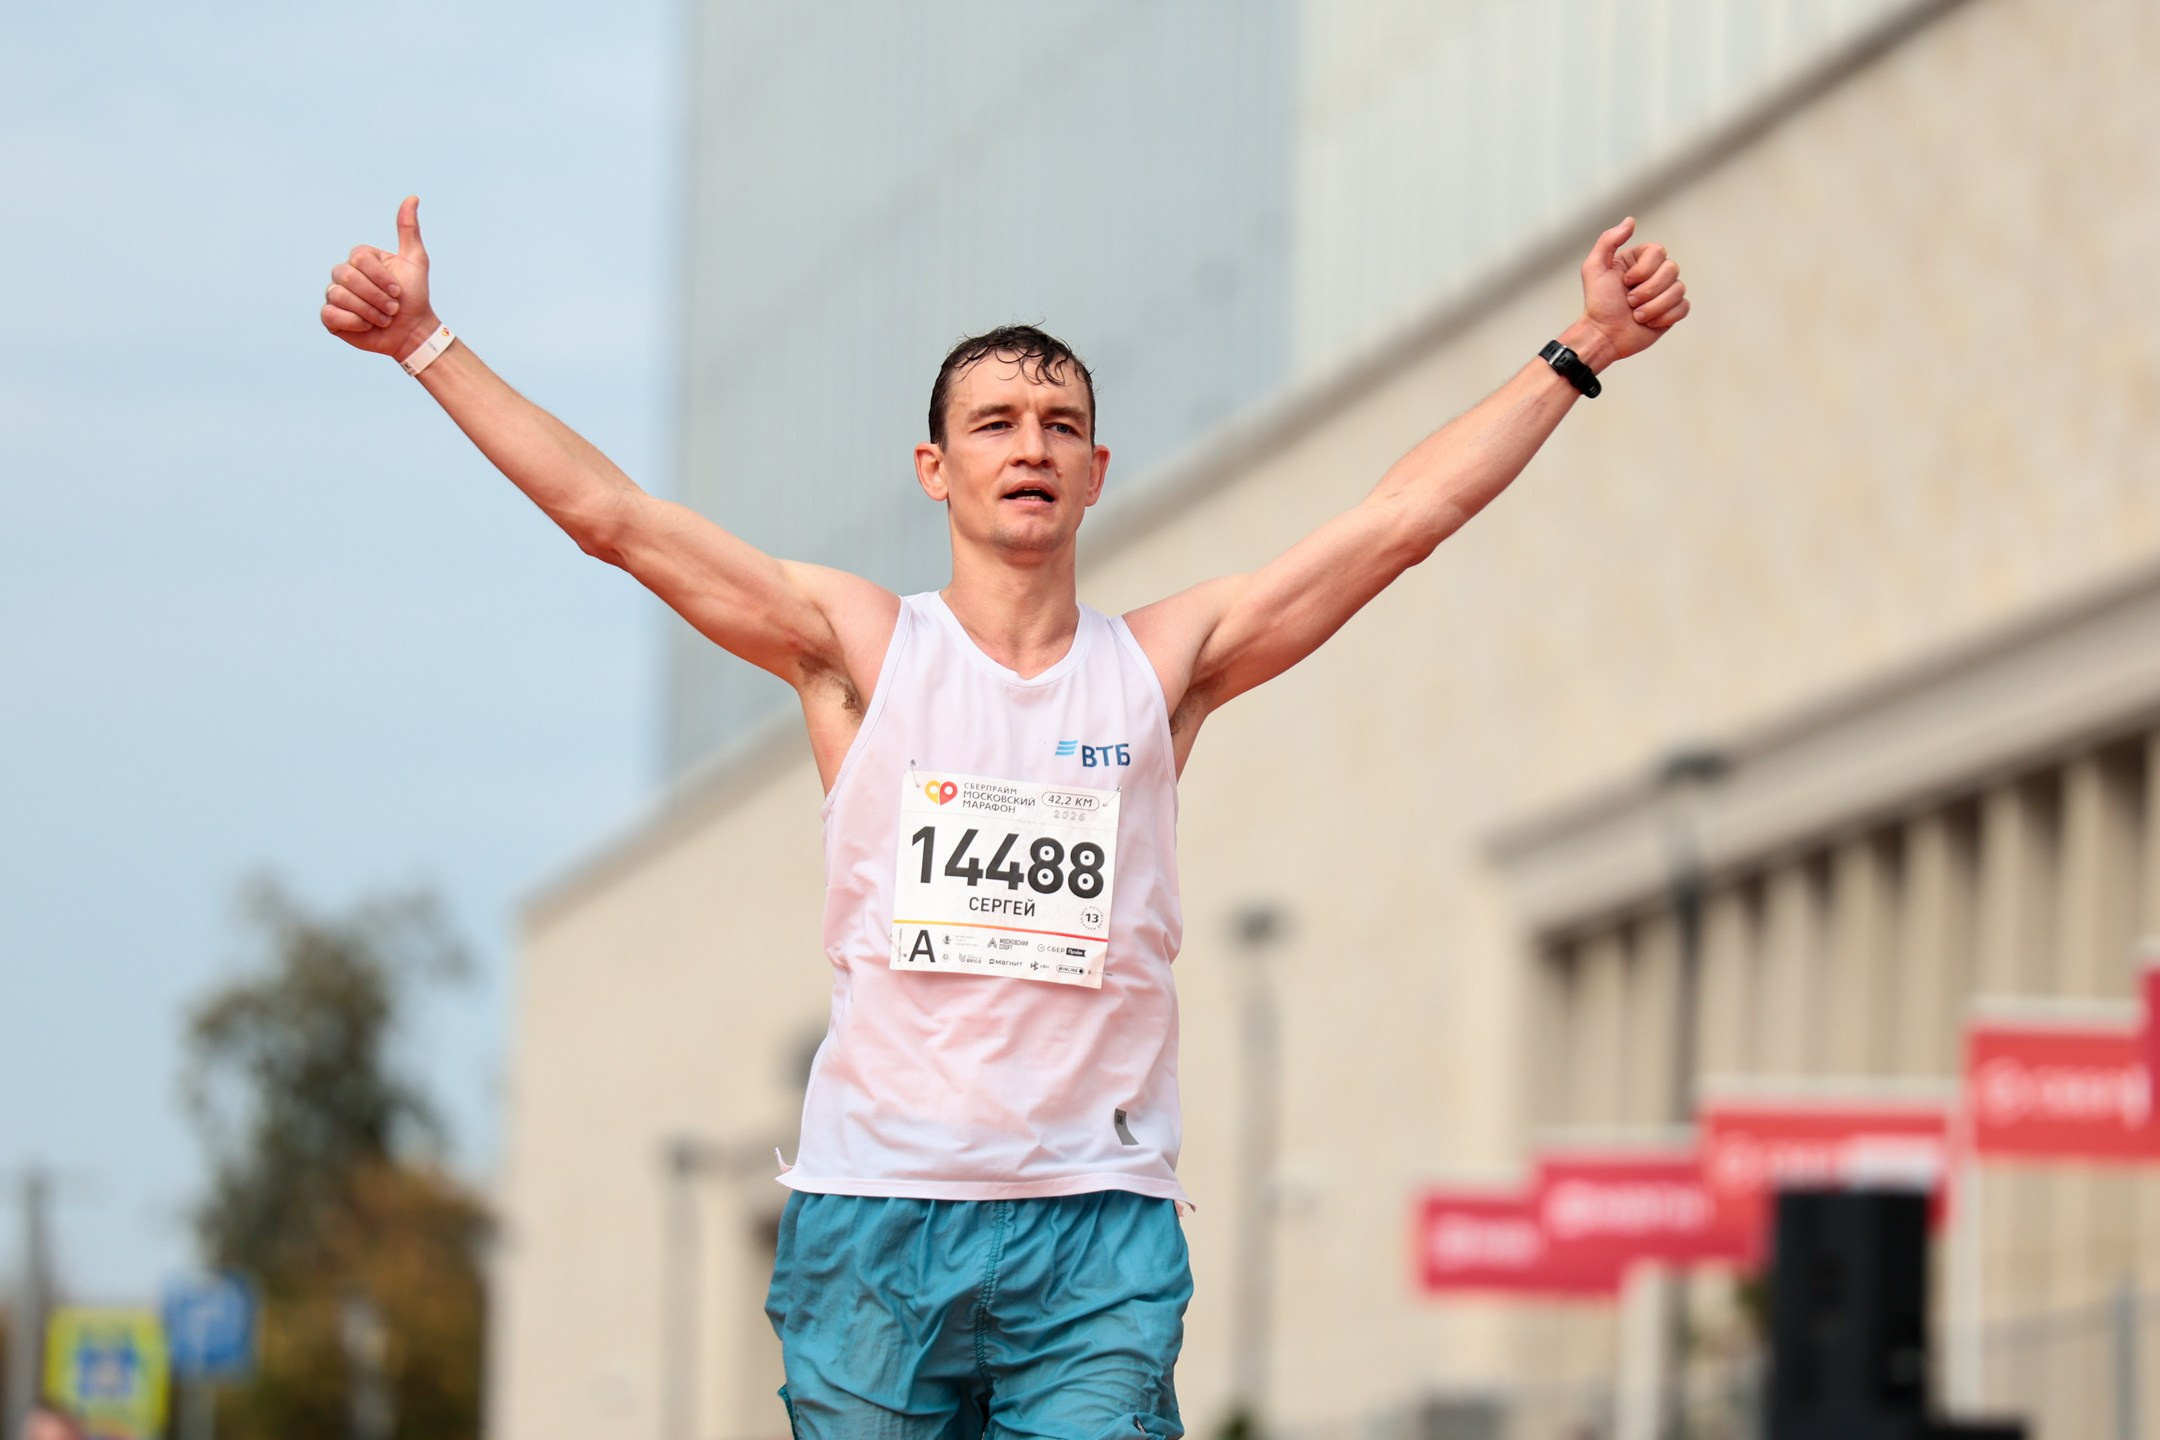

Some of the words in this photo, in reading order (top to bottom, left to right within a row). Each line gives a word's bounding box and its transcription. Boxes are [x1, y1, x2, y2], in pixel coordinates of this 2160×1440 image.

[1081, 743, 1131, 768] ВТБ
[963, 782, 1018, 795] СБЕРПРАЙМ
[962, 790, 1037, 807] МОСКОВСКИЙ
[962, 799, 1016, 814] МАРАФОН
[1048, 794, 1072, 806] 42,2
[1075, 797, 1093, 808] КМ
[911, 825, 1106, 900] 14488
[968, 896, 1036, 917] СЕРГЕЙ
[1085, 912, 1099, 924] 13
